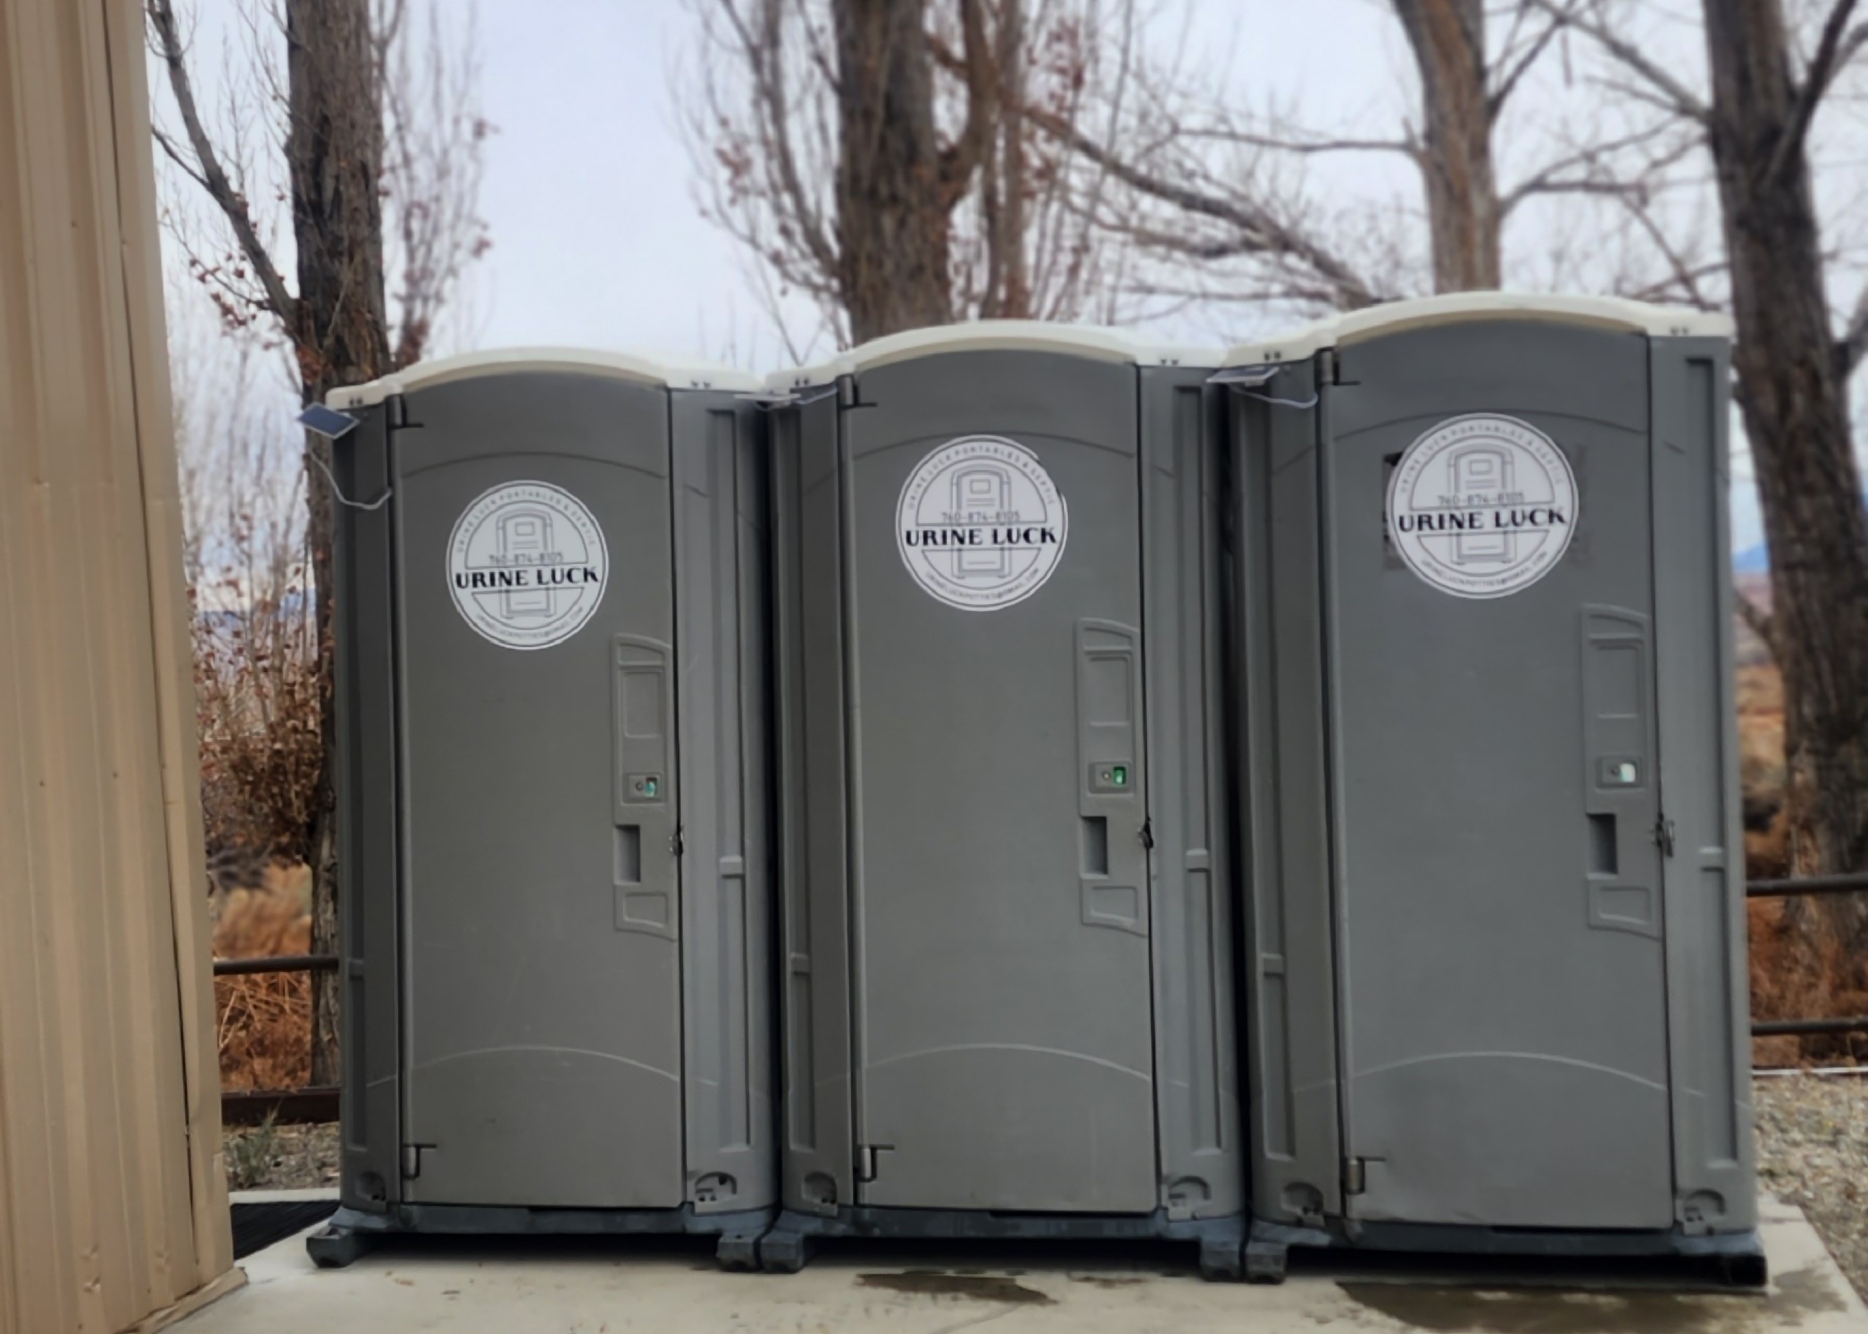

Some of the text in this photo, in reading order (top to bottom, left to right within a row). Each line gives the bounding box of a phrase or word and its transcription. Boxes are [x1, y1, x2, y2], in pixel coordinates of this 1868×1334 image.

[1422, 434, 1448, 457] LUCK
[1451, 424, 1524, 439] PORTABLES
[927, 454, 951, 476] LUCK
[955, 445, 1020, 462] PORTABLES
[474, 499, 496, 520] LUCK
[500, 489, 562, 505] PORTABLES
[1399, 506, 1567, 532] URINE LUCK
[906, 527, 1057, 546] URINE LUCK
[455, 567, 599, 589] URINE LUCK
